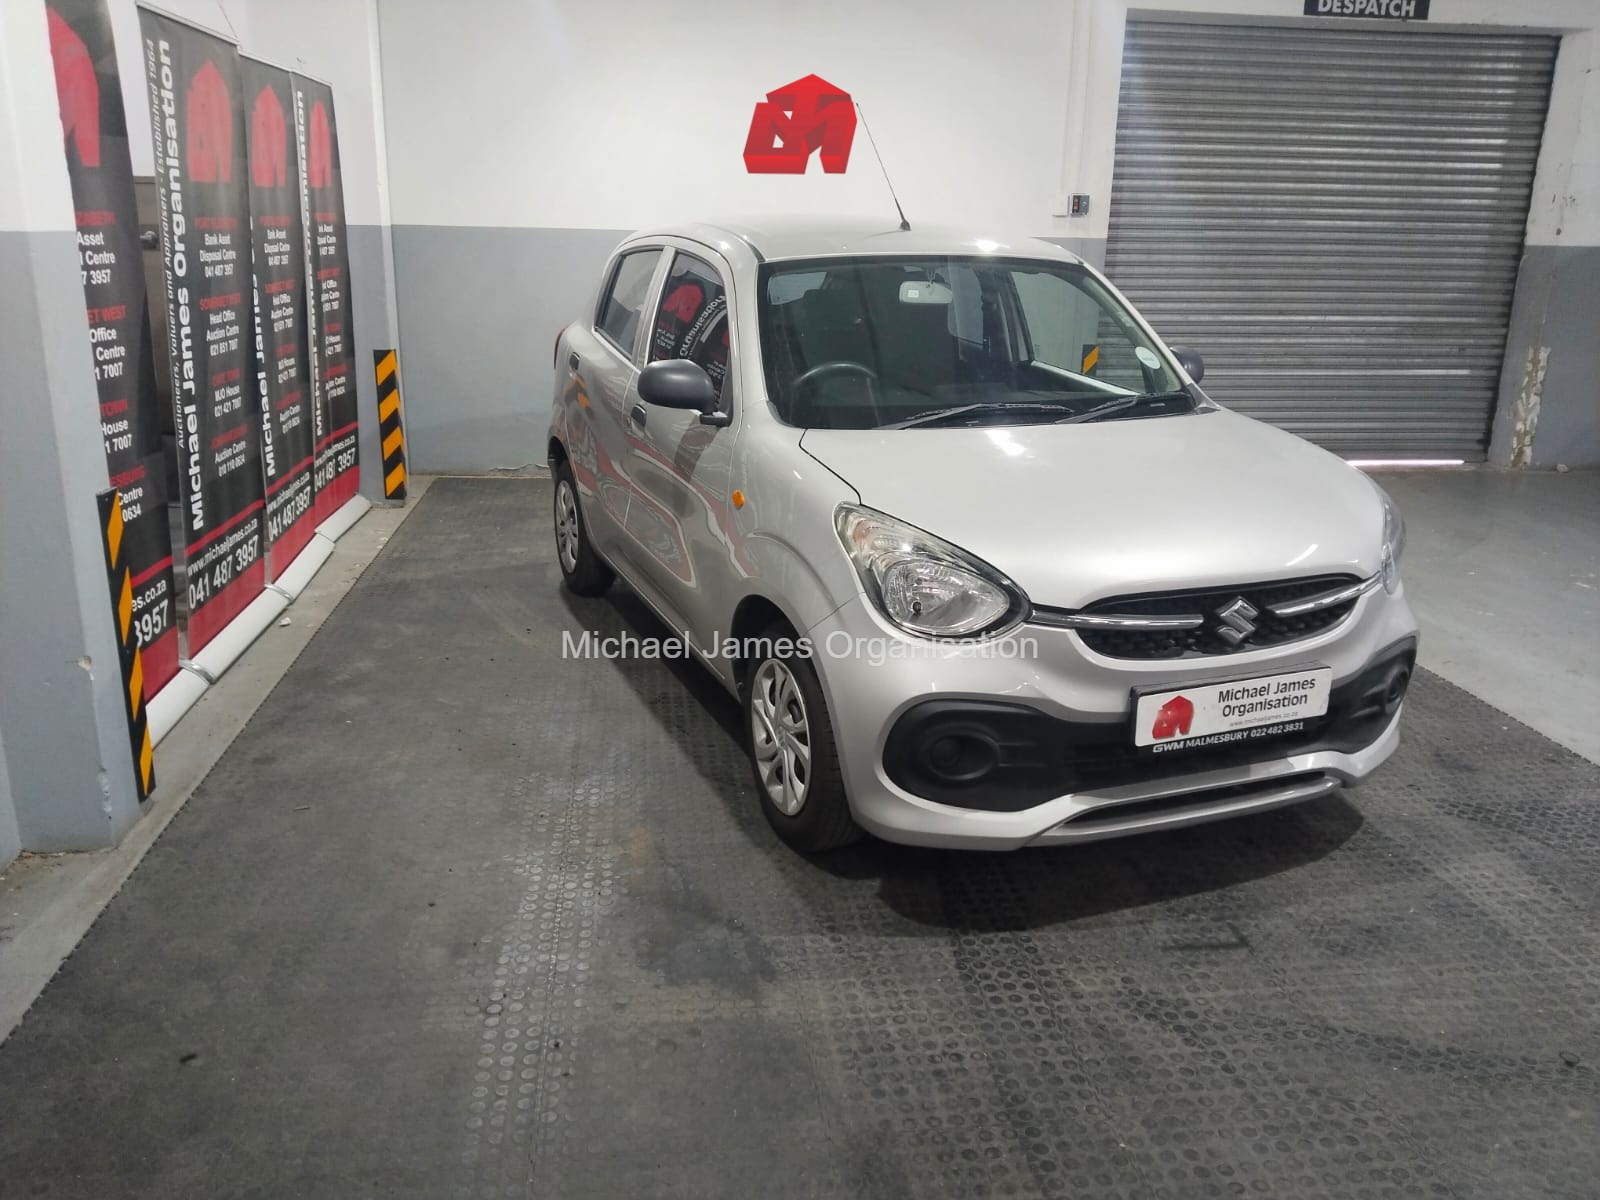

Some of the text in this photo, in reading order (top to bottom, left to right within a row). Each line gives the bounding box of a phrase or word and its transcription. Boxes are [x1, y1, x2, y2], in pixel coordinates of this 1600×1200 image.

[1317, 0, 1416, 17] DESPATCH
[76, 230, 105, 246] Asset
[85, 250, 117, 266] Centre
[89, 268, 111, 285] 3957
[158, 39, 204, 531] Michael James Organisation
[89, 326, 117, 343] Office
[95, 345, 126, 361] Centre
[102, 361, 123, 379] 7007
[257, 370, 276, 477] Michael
[112, 434, 132, 452] 7007
[337, 447, 356, 473] 3957
[122, 503, 142, 522] 0634
[188, 533, 259, 610] 041 487 3957
[134, 598, 169, 650] 3957
[1217, 678, 1316, 703] Michael James
[1222, 694, 1308, 717] Organisation
[1152, 740, 1185, 753] GWM
[1185, 730, 1249, 749] MALMESBURY
